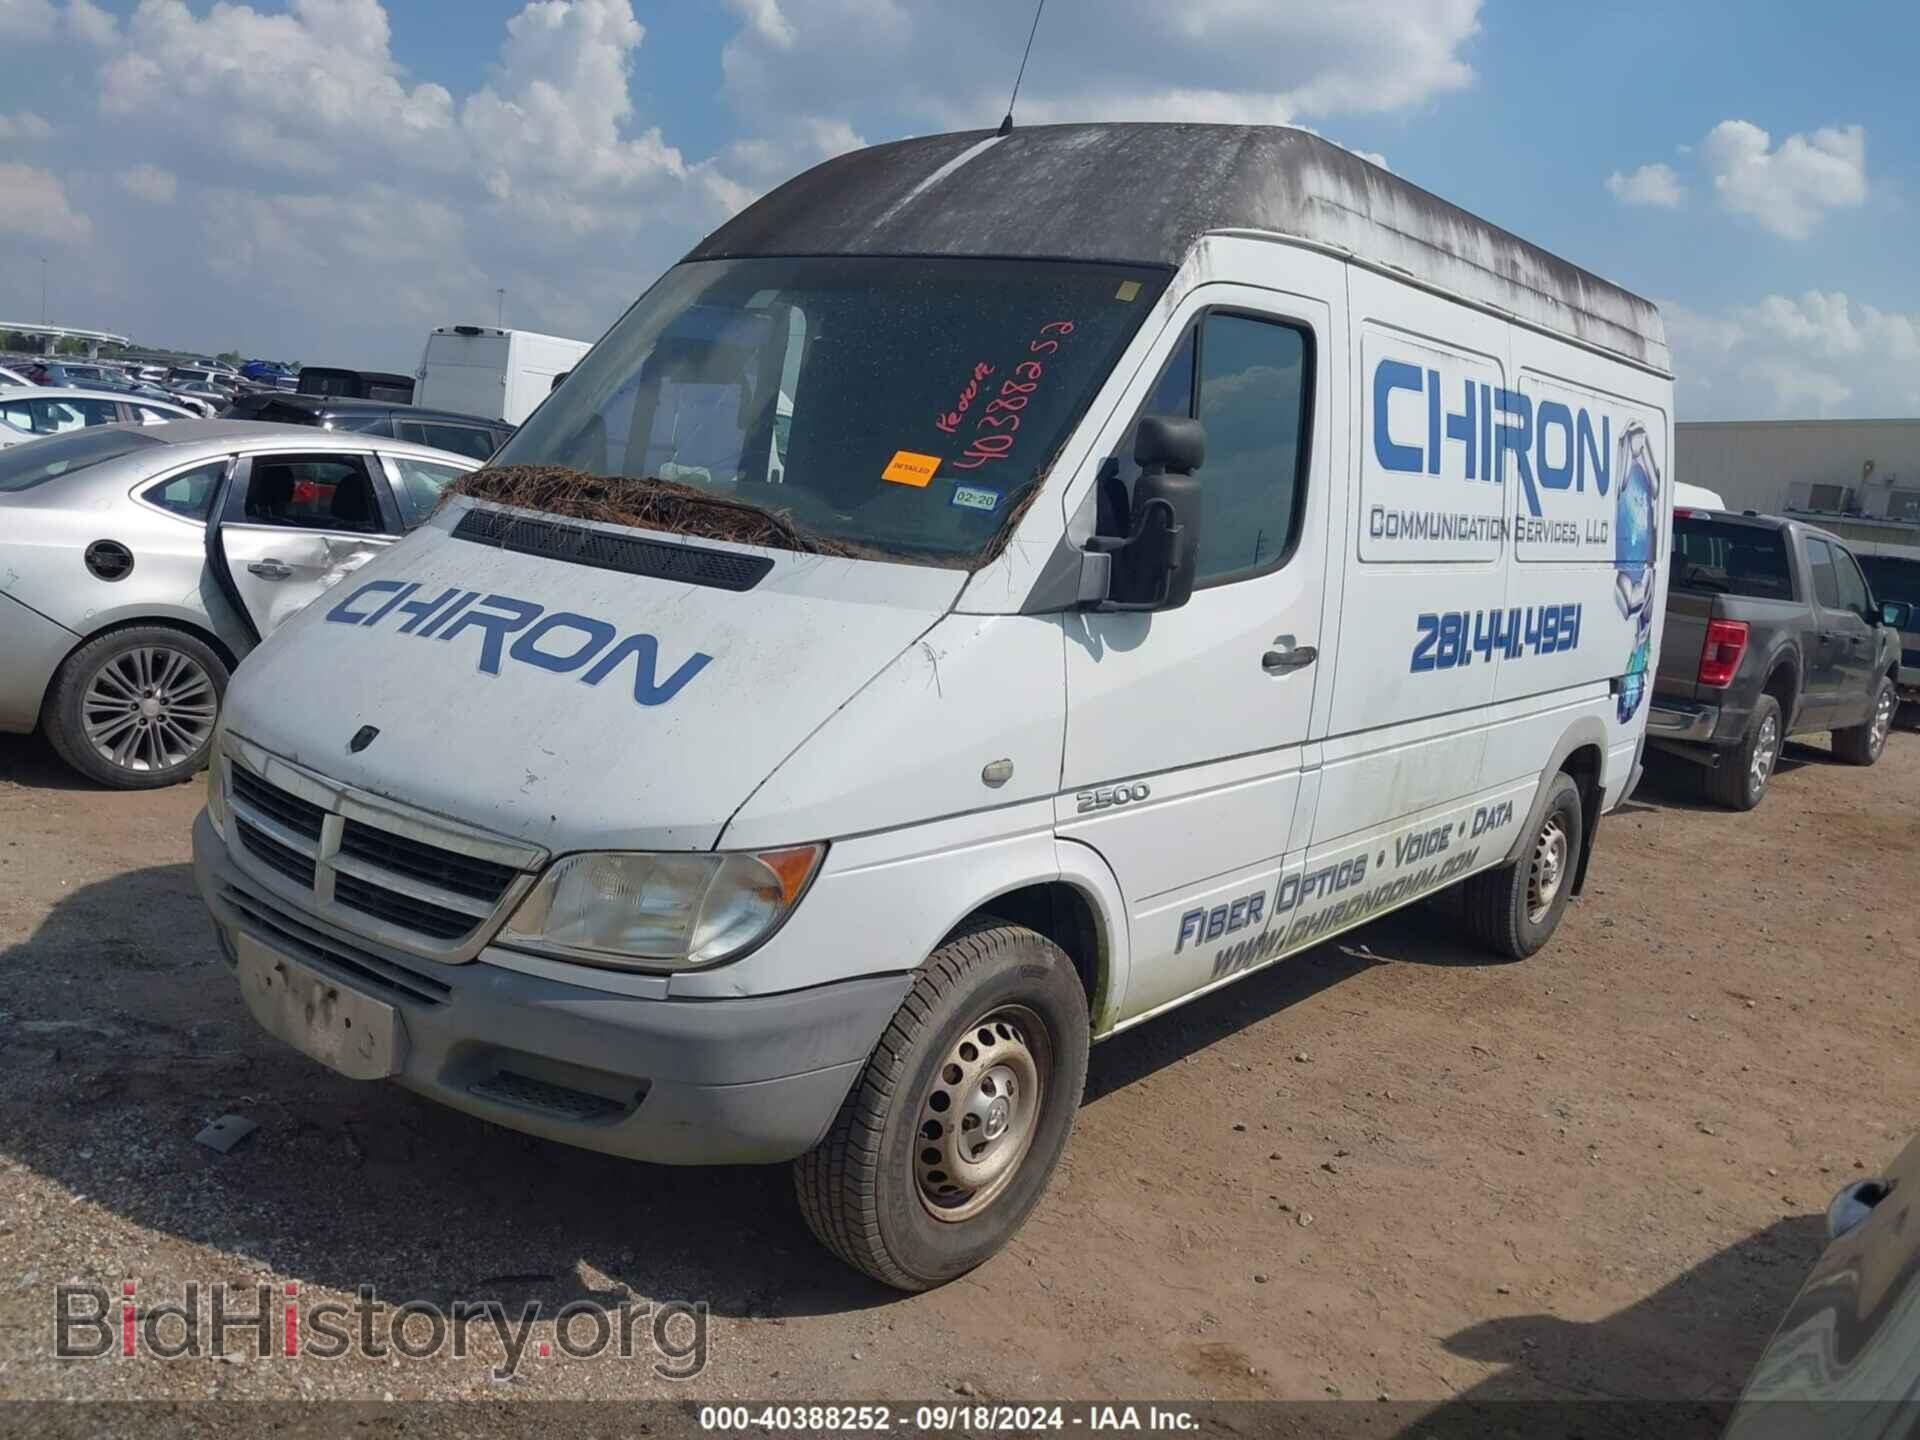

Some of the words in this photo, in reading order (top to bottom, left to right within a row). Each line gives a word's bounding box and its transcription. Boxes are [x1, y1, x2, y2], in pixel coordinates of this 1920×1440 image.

[953, 320, 1074, 468] 40388252
[1373, 358, 1610, 517] CHIRON
[1585, 520, 1609, 545] LLC
[325, 579, 714, 707] CHIRON
[1410, 603, 1583, 673] 281.441.4951
[1076, 781, 1151, 814] 2500
